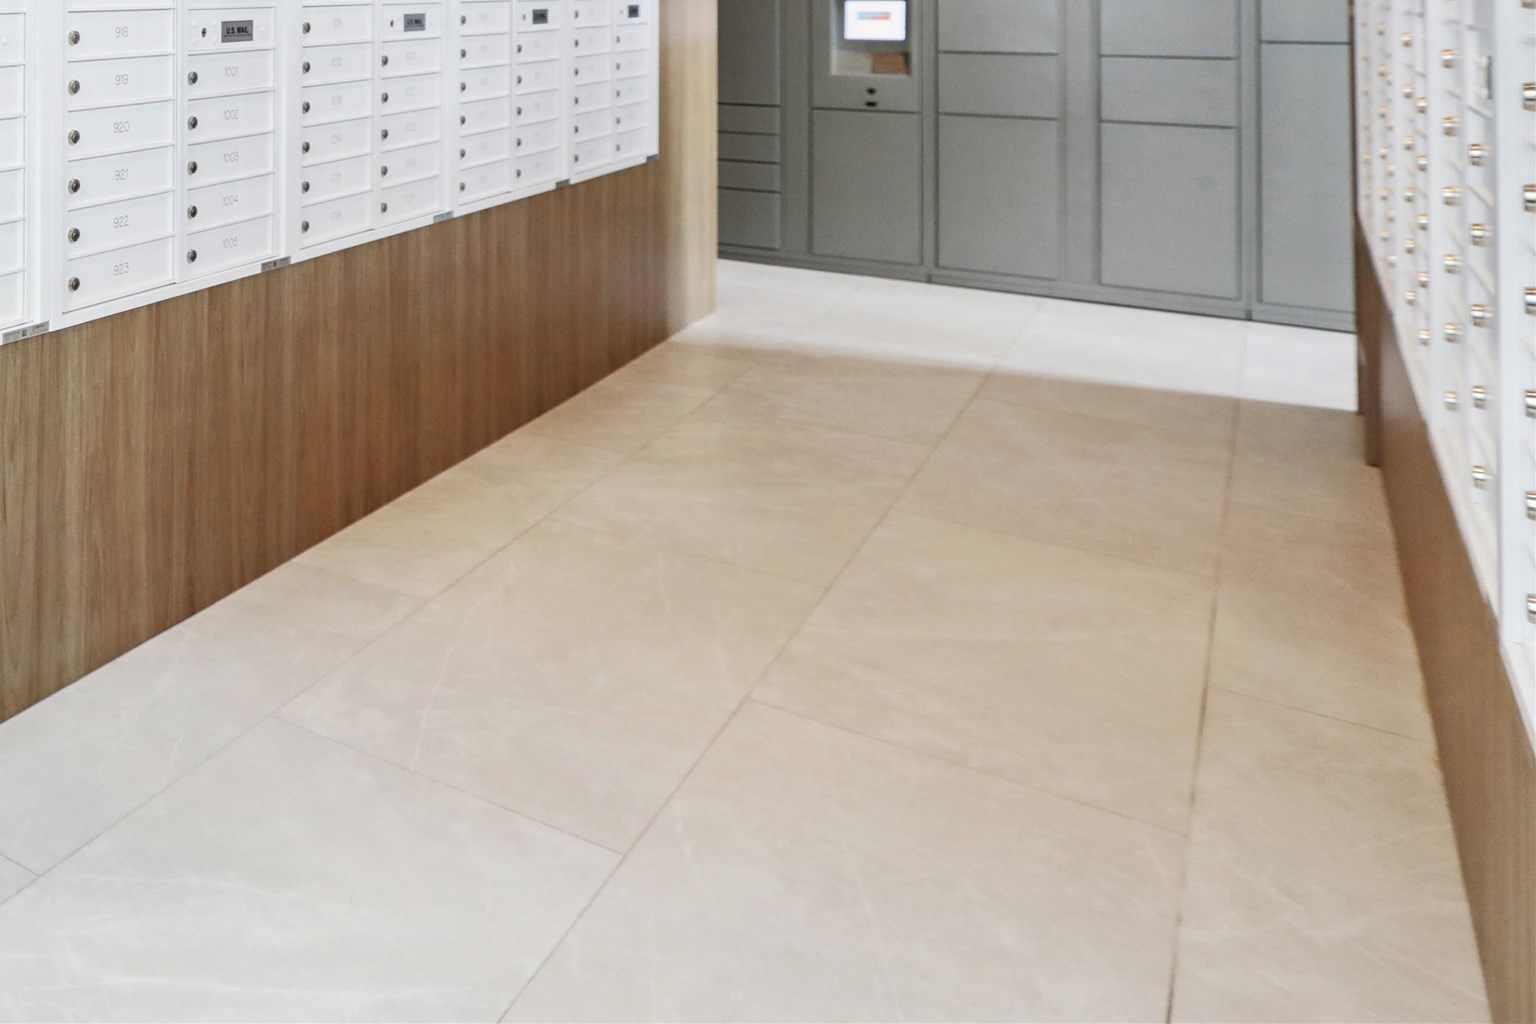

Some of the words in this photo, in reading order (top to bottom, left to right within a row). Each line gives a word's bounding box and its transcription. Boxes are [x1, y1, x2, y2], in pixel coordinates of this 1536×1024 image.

[116, 74, 128, 85] 919
[114, 122, 130, 132] 920
[114, 169, 128, 180] 921
[114, 216, 130, 228] 922
[114, 263, 130, 274] 923
